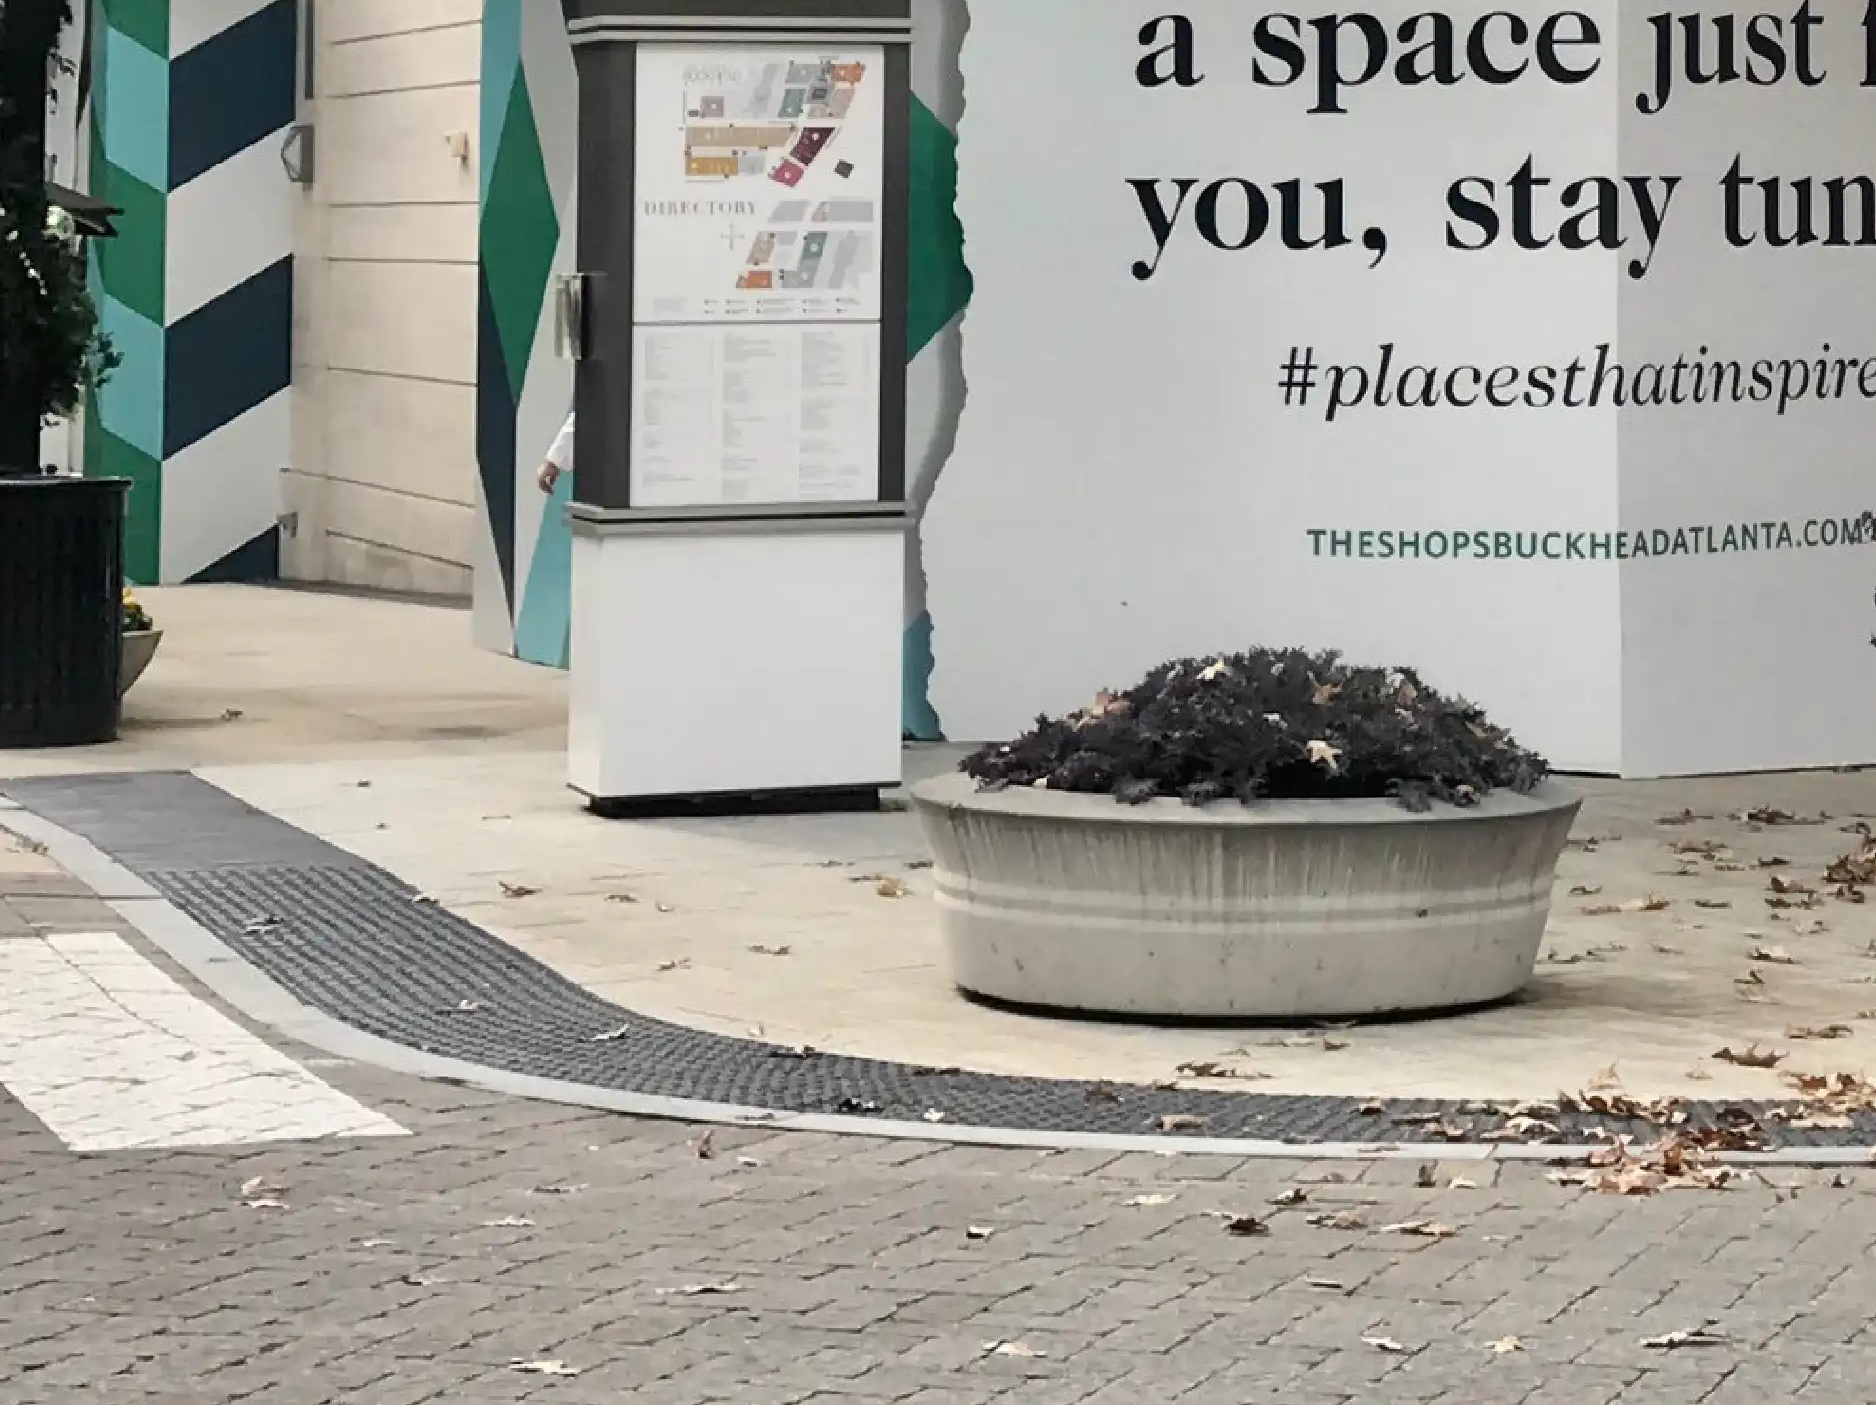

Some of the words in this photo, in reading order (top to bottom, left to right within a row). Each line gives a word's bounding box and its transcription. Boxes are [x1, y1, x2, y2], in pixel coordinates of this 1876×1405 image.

[1134, 13, 1206, 89] a
[1250, 9, 1602, 115] space
[644, 200, 756, 216] DIRECTORY
[1125, 176, 1390, 281] you,
[1445, 152, 1682, 281] stay
[1306, 519, 1862, 561] THESHOPSBUCKHEADATLANTA.COM
